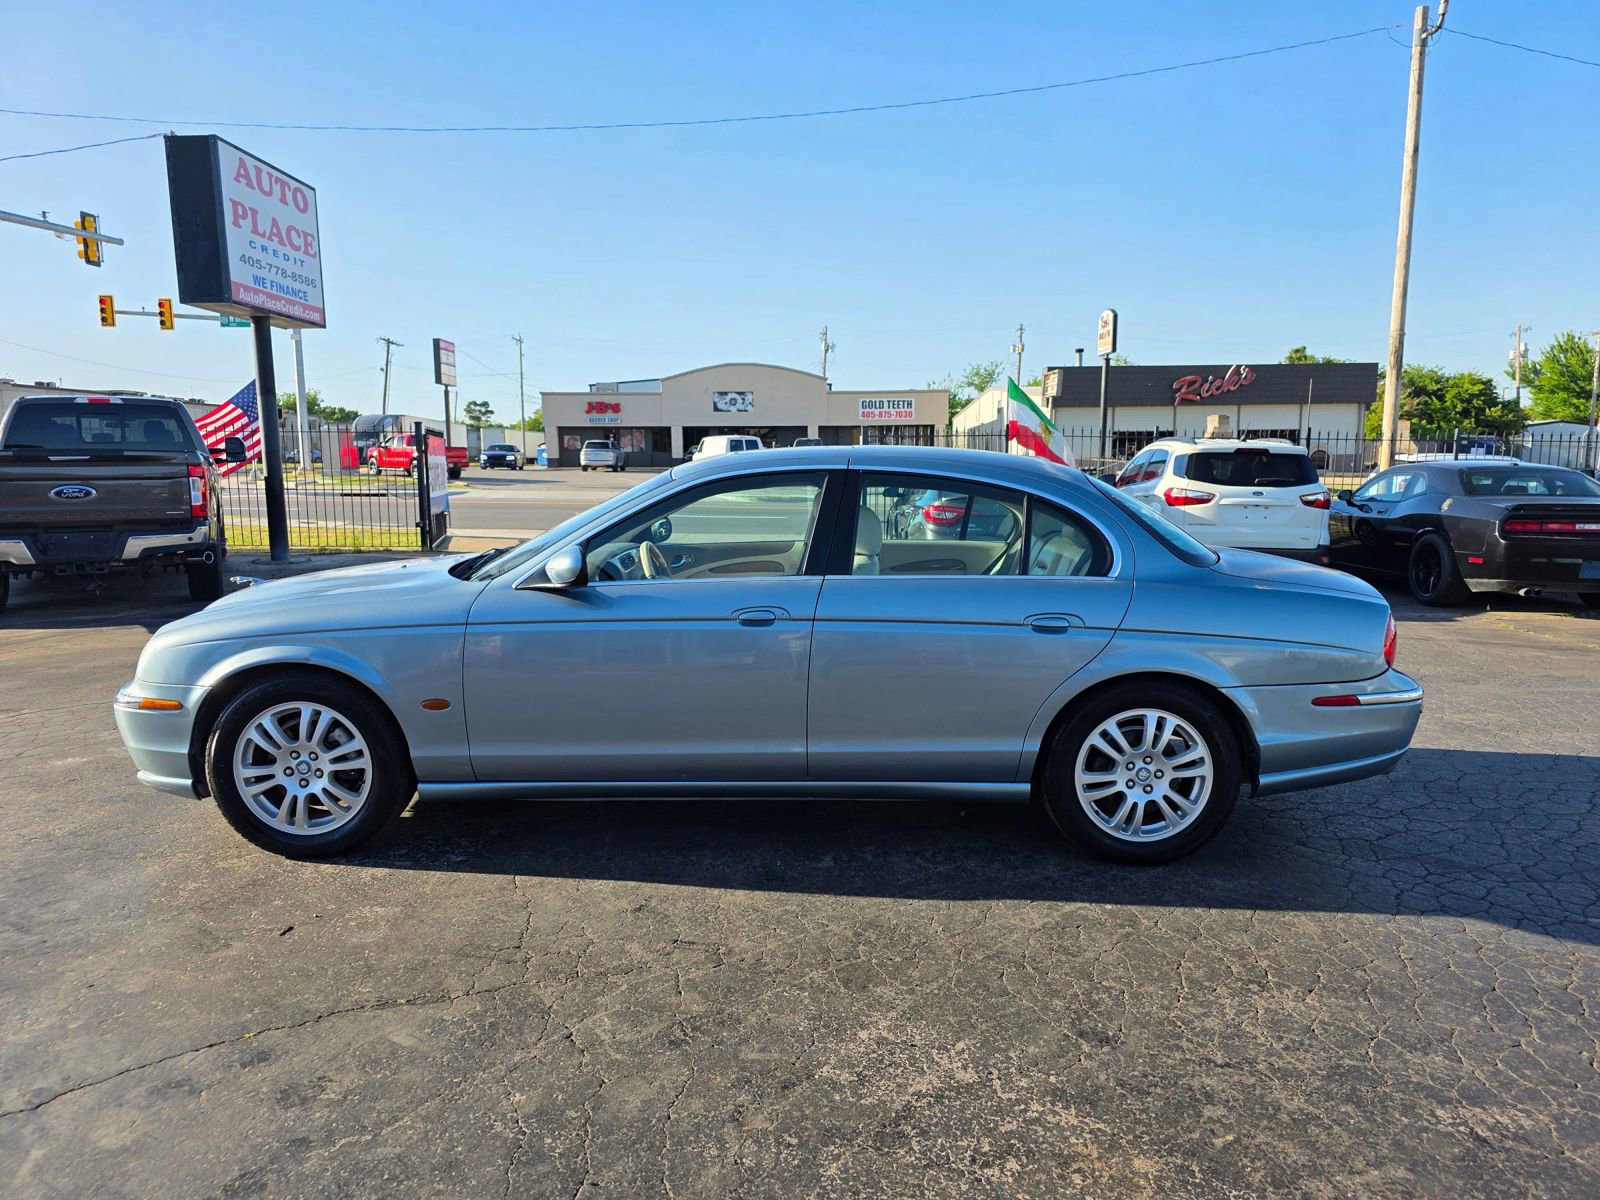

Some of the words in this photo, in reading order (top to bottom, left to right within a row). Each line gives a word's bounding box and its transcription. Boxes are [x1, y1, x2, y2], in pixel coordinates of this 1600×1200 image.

[233, 157, 309, 214] AUTO
[229, 198, 317, 259] PLACE
[249, 240, 305, 267] CREDIT
[240, 254, 317, 288] 405-778-8586
[252, 273, 268, 289] WE
[270, 280, 309, 302] FINANCE
[239, 287, 320, 321] AutoPlaceCredit.com
[1173, 364, 1256, 407] Rick's
[861, 399, 885, 410] GOLD
[887, 399, 913, 410] TEETH
[61, 488, 86, 498] Ford
